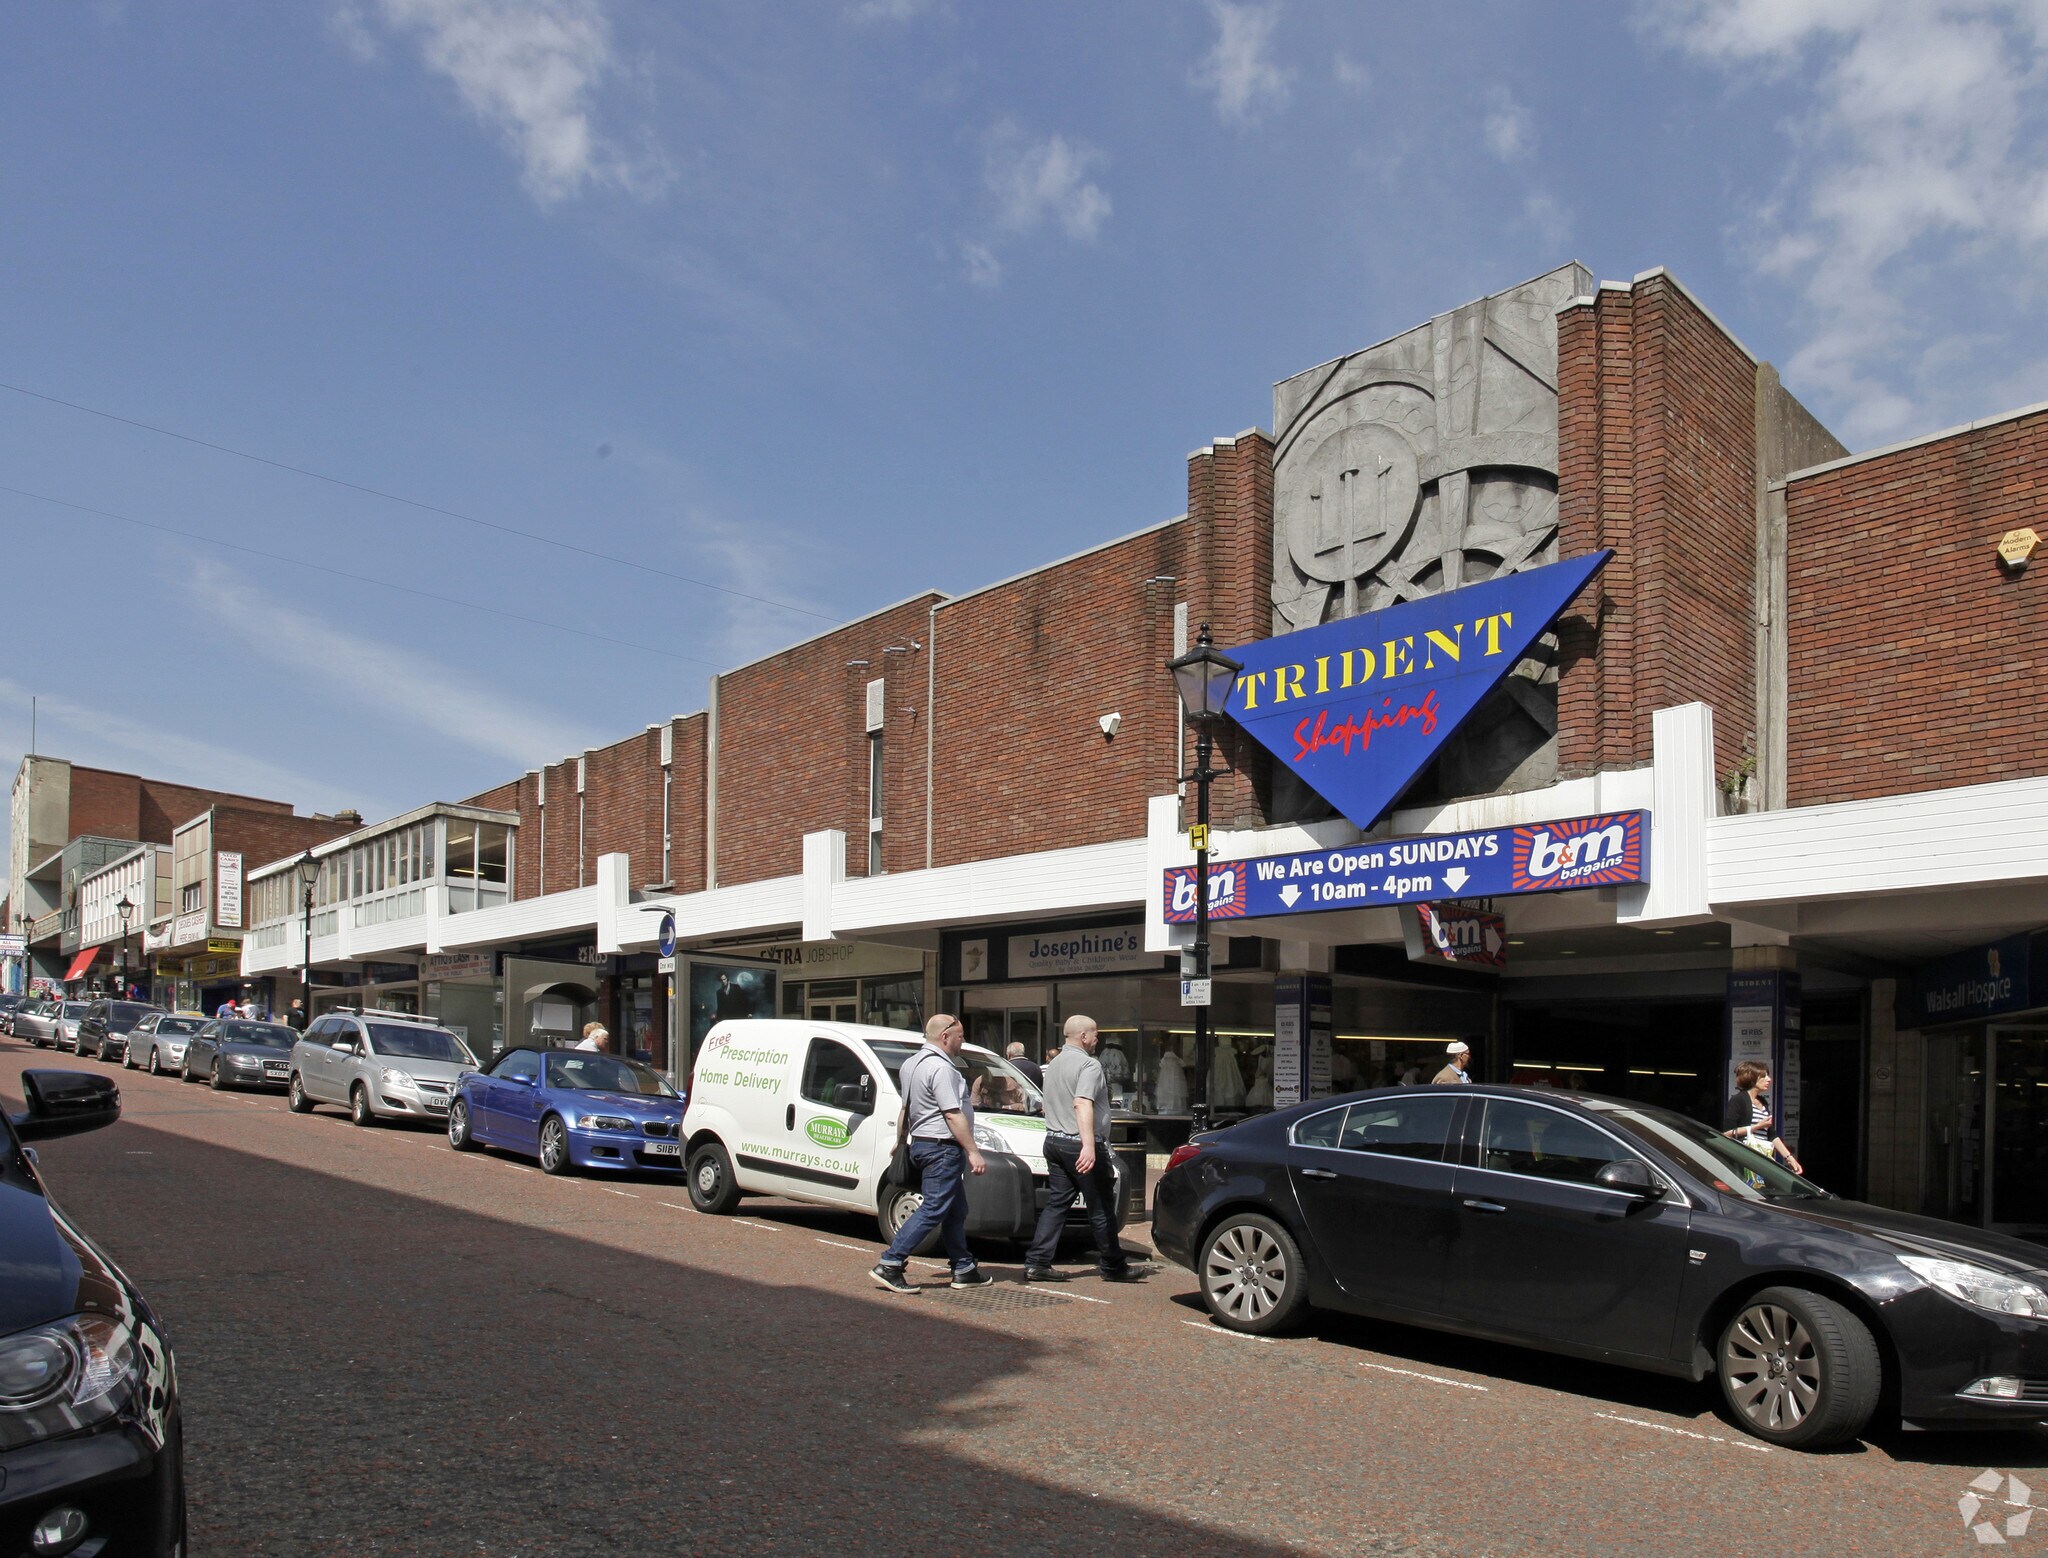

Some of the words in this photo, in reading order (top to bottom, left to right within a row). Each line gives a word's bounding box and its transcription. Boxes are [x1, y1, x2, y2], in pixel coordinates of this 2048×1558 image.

[2002, 535, 2032, 546] Modern
[2004, 544, 2031, 554] Alarms
[1237, 611, 1514, 709] TRIDENT
[1293, 689, 1440, 763] Shopping
[1191, 826, 1205, 848] H
[1256, 859, 1285, 881] We
[1289, 855, 1324, 879] Are
[1327, 850, 1384, 881] Open
[1388, 834, 1499, 867] SUNDAYS
[1527, 822, 1626, 878] b&m
[1560, 856, 1624, 881] bargains
[1310, 881, 1367, 903] 10am
[1383, 873, 1433, 901] 4pm
[1429, 911, 1481, 949] b&m
[806, 945, 855, 964] JOBSHOP
[1029, 930, 1138, 960] Josephine's
[1451, 944, 1482, 957] bargains
[1029, 960, 1053, 969] Quality
[1055, 958, 1072, 967] Baby
[1073, 957, 1079, 965] &
[1082, 955, 1116, 964] Childrens
[1119, 953, 1138, 962] Wear
[1732, 979, 1773, 988] TRIDENT
[1926, 983, 1966, 1013] Walsall
[1967, 976, 2012, 1008] Hospice
[707, 1032, 732, 1050] Free
[1748, 1028, 1763, 1036] RBS
[720, 1044, 788, 1066] Prescription
[698, 1067, 729, 1087] Home
[733, 1071, 782, 1095] Delivery
[810, 1122, 847, 1139] MURRAYS
[740, 1140, 860, 1175] www.murrays.co.uk
